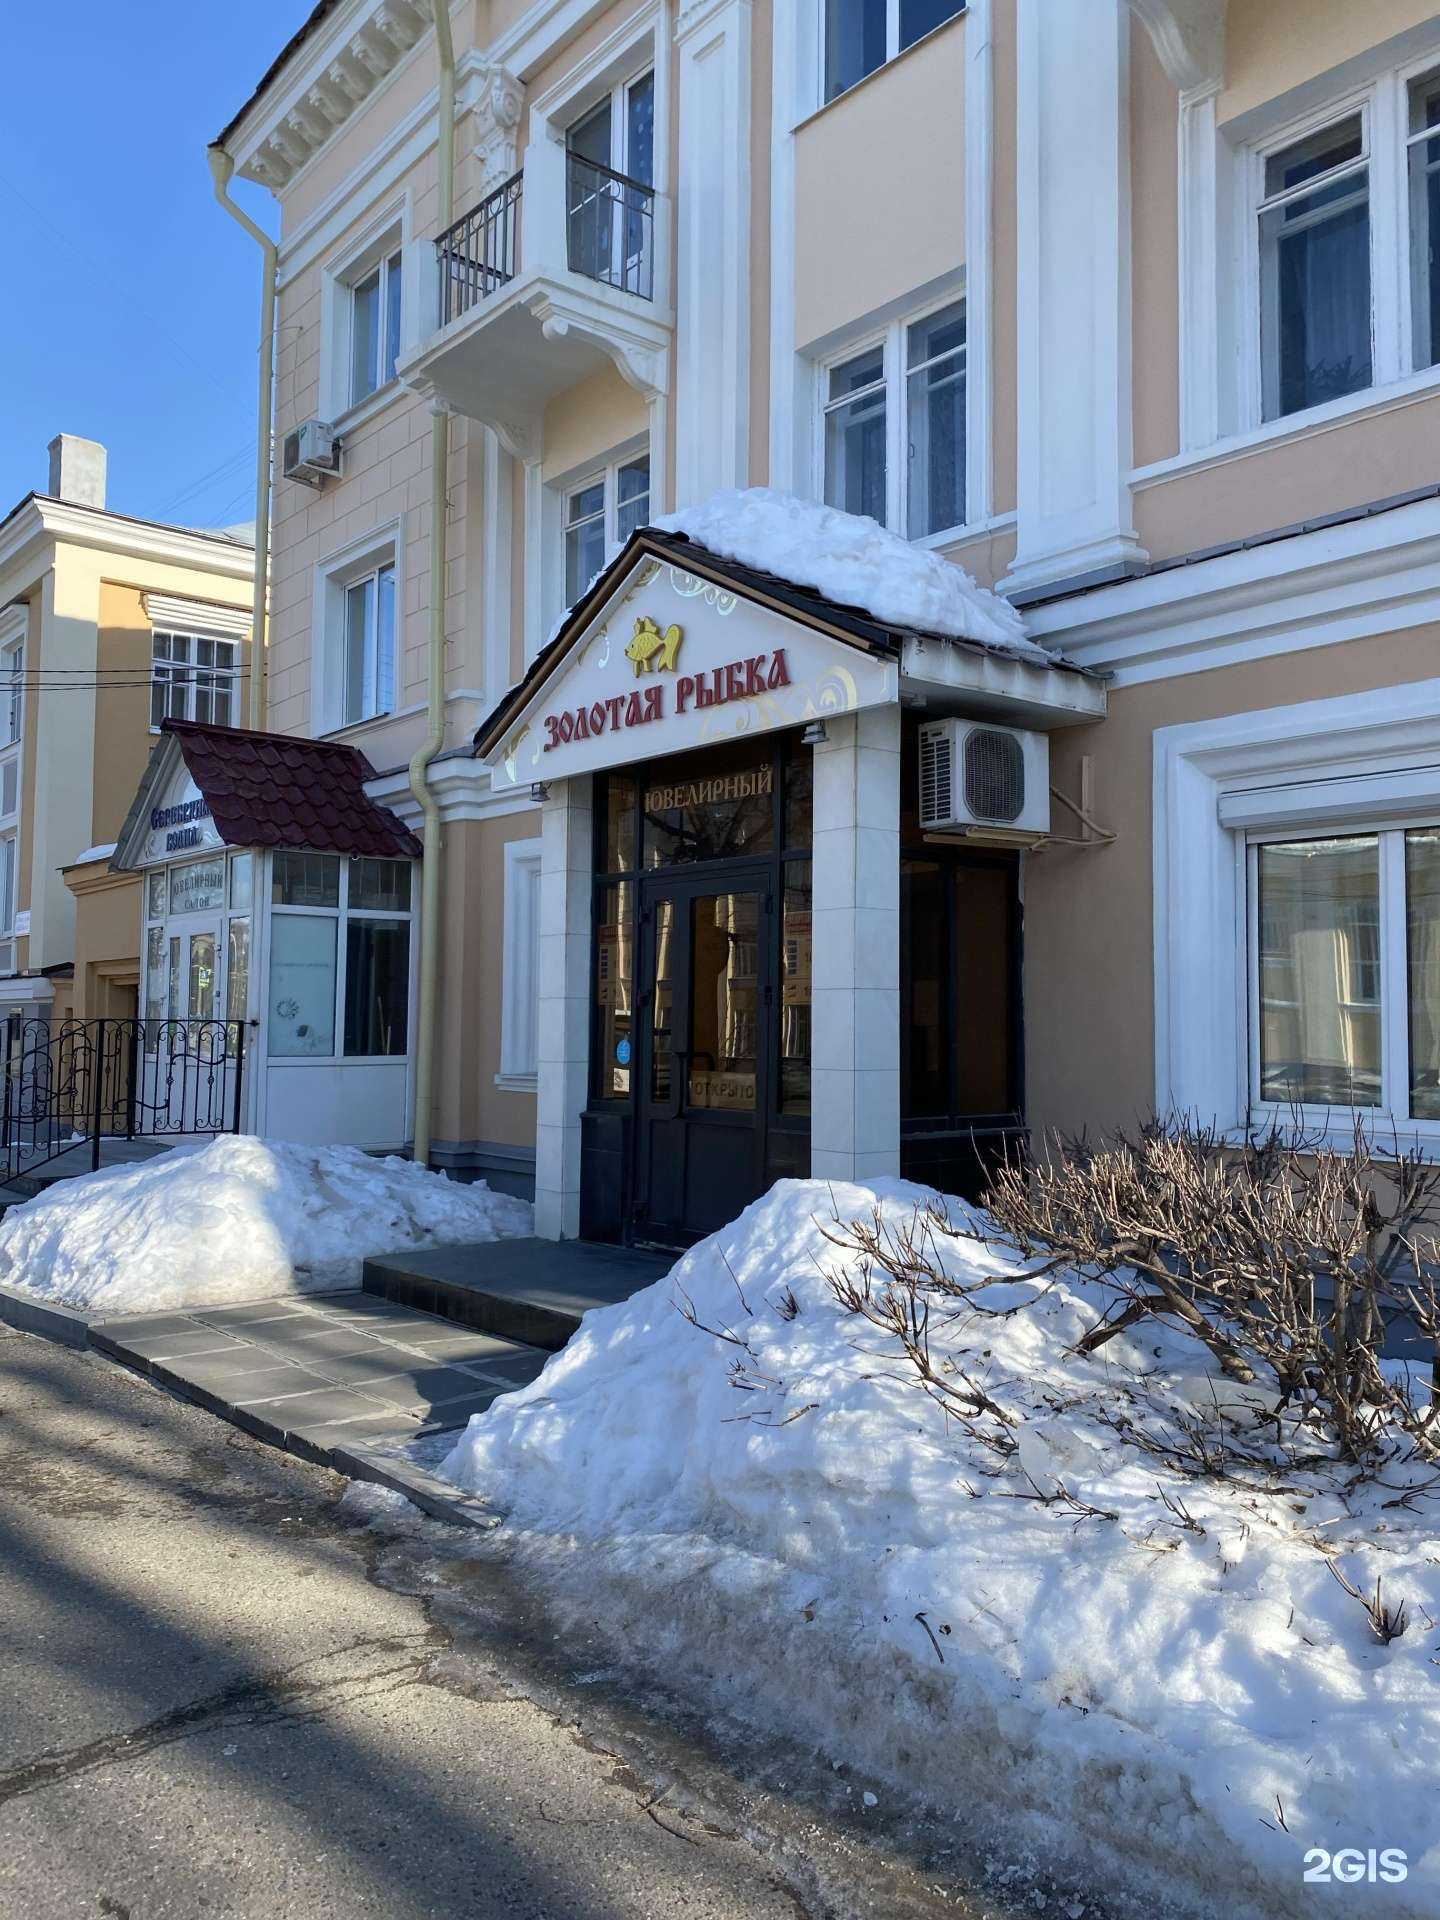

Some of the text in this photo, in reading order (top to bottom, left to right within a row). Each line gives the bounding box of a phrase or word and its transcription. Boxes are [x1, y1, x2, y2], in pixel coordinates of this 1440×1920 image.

[543, 648, 792, 753] ЗОЛОТАЯ РЫБКА
[644, 763, 773, 813] ЮВЕЛИРНЫЙ
